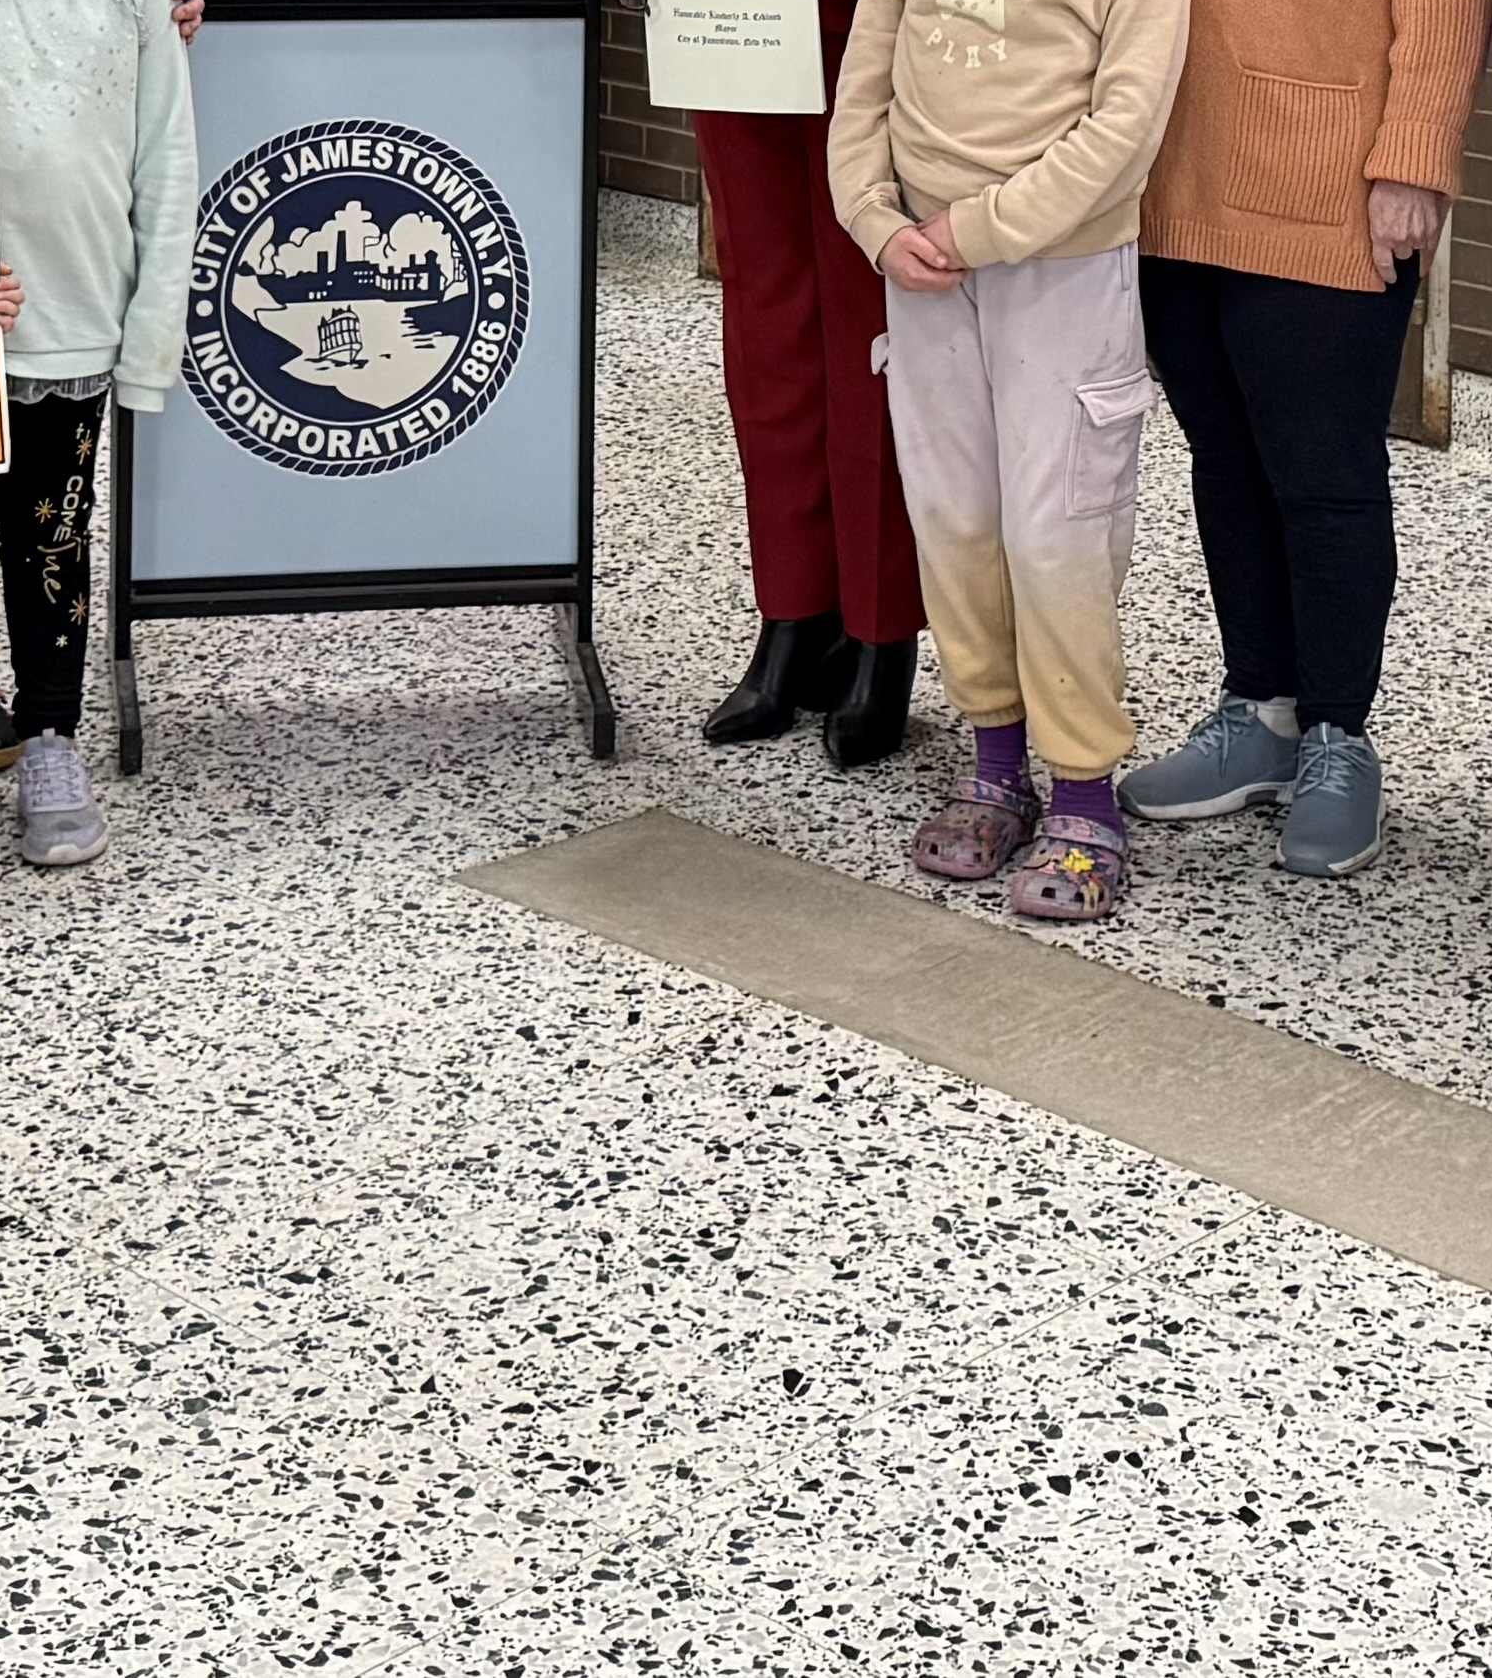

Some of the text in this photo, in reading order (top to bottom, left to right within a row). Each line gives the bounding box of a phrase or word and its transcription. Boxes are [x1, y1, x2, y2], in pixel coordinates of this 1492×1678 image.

[924, 27, 1007, 69] PLAY
[190, 137, 514, 292] CITY OF JAMESTOWN N.Y.
[191, 318, 508, 459] INCORPORATED 1886
